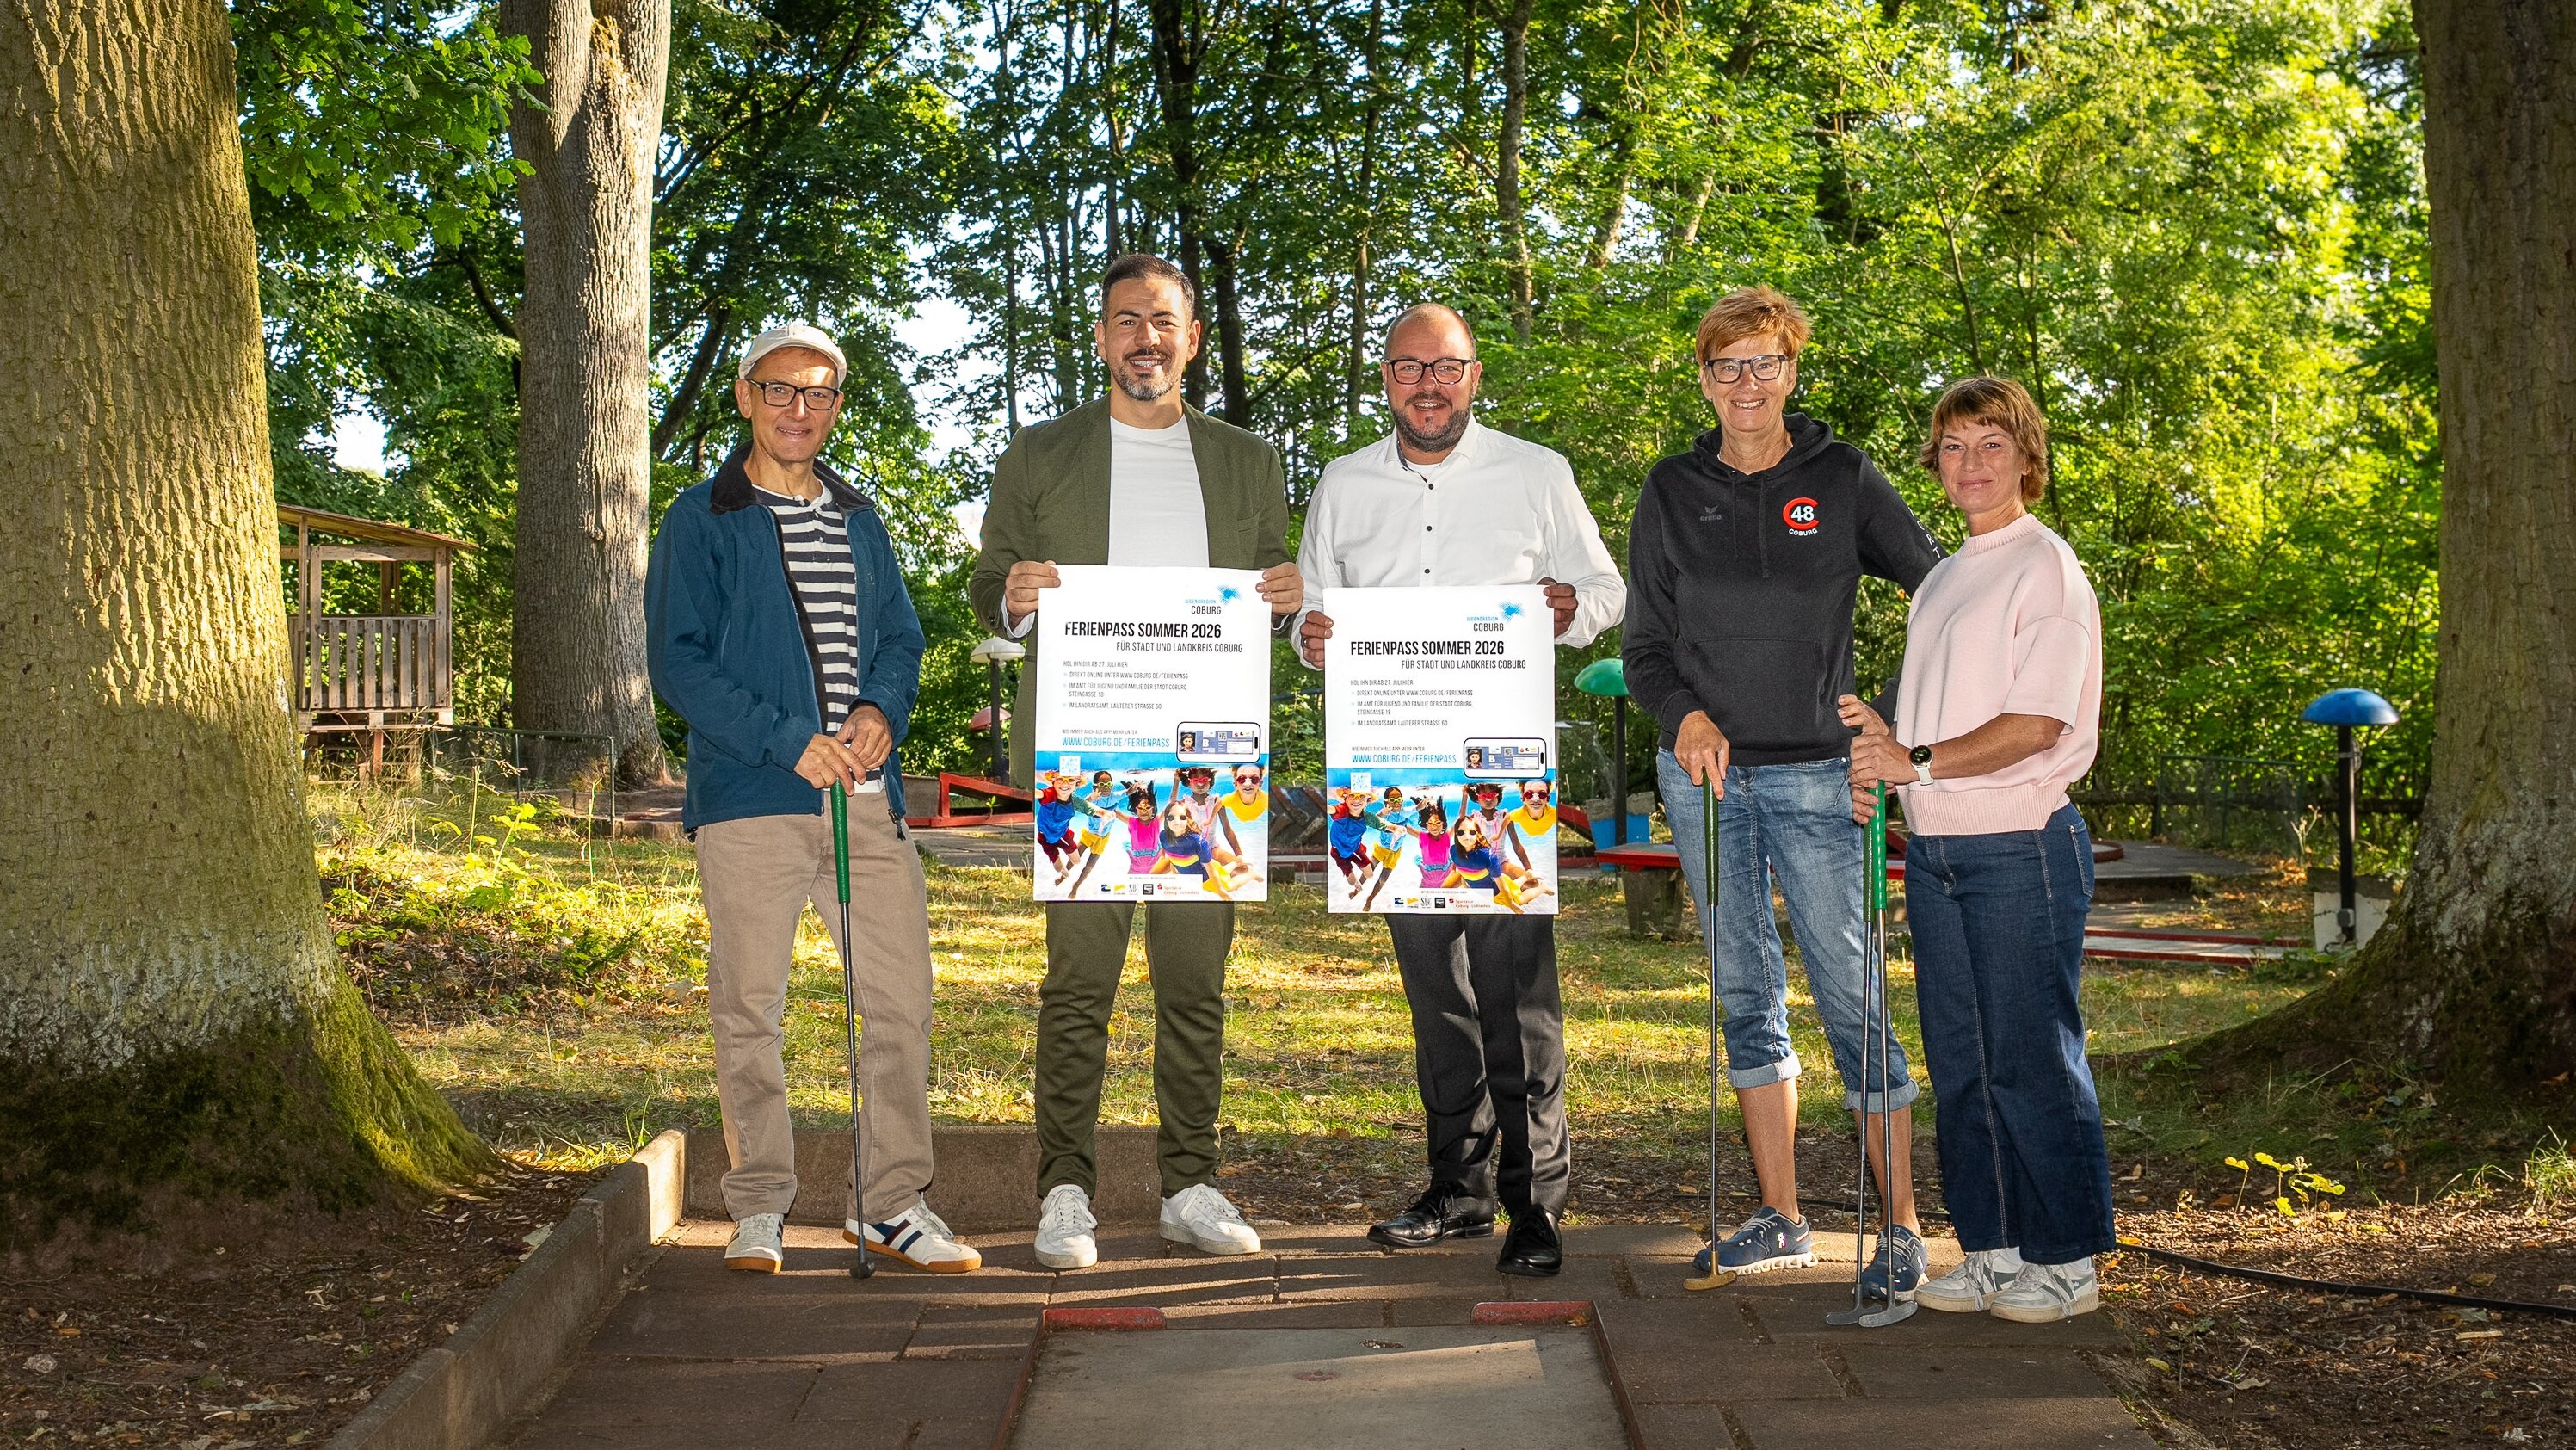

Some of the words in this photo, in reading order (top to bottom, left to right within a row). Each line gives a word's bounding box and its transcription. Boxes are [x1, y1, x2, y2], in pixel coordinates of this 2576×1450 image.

[1791, 506, 1814, 521] 48
[1191, 605, 1222, 614] COBURG
[1065, 621, 1135, 637] FERIENPASS
[1137, 622, 1188, 638] SOMMER
[1192, 623, 1222, 639] 2026
[1473, 623, 1504, 632] COBURG
[1116, 640, 1131, 651] FÜR
[1131, 642, 1155, 651] STADT
[1156, 642, 1172, 652] UND
[1173, 643, 1213, 652] LANDKREIS
[1214, 643, 1243, 653] COBURG
[1351, 641, 1419, 656] FERIENPASS
[1421, 641, 1471, 655] SOMMER
[1475, 641, 1504, 655] 2026
[1401, 658, 1415, 669] FÜR
[1416, 660, 1439, 669] STADT
[1440, 660, 1456, 669] UND
[1457, 659, 1497, 669] LANDKREIS
[1498, 659, 1526, 669] COBURG
[1062, 737, 1170, 747] WWW.COBURG.DE/FERIENPASS
[1352, 754, 1457, 763] WWW.COBURG.DE/FERIENPASS
